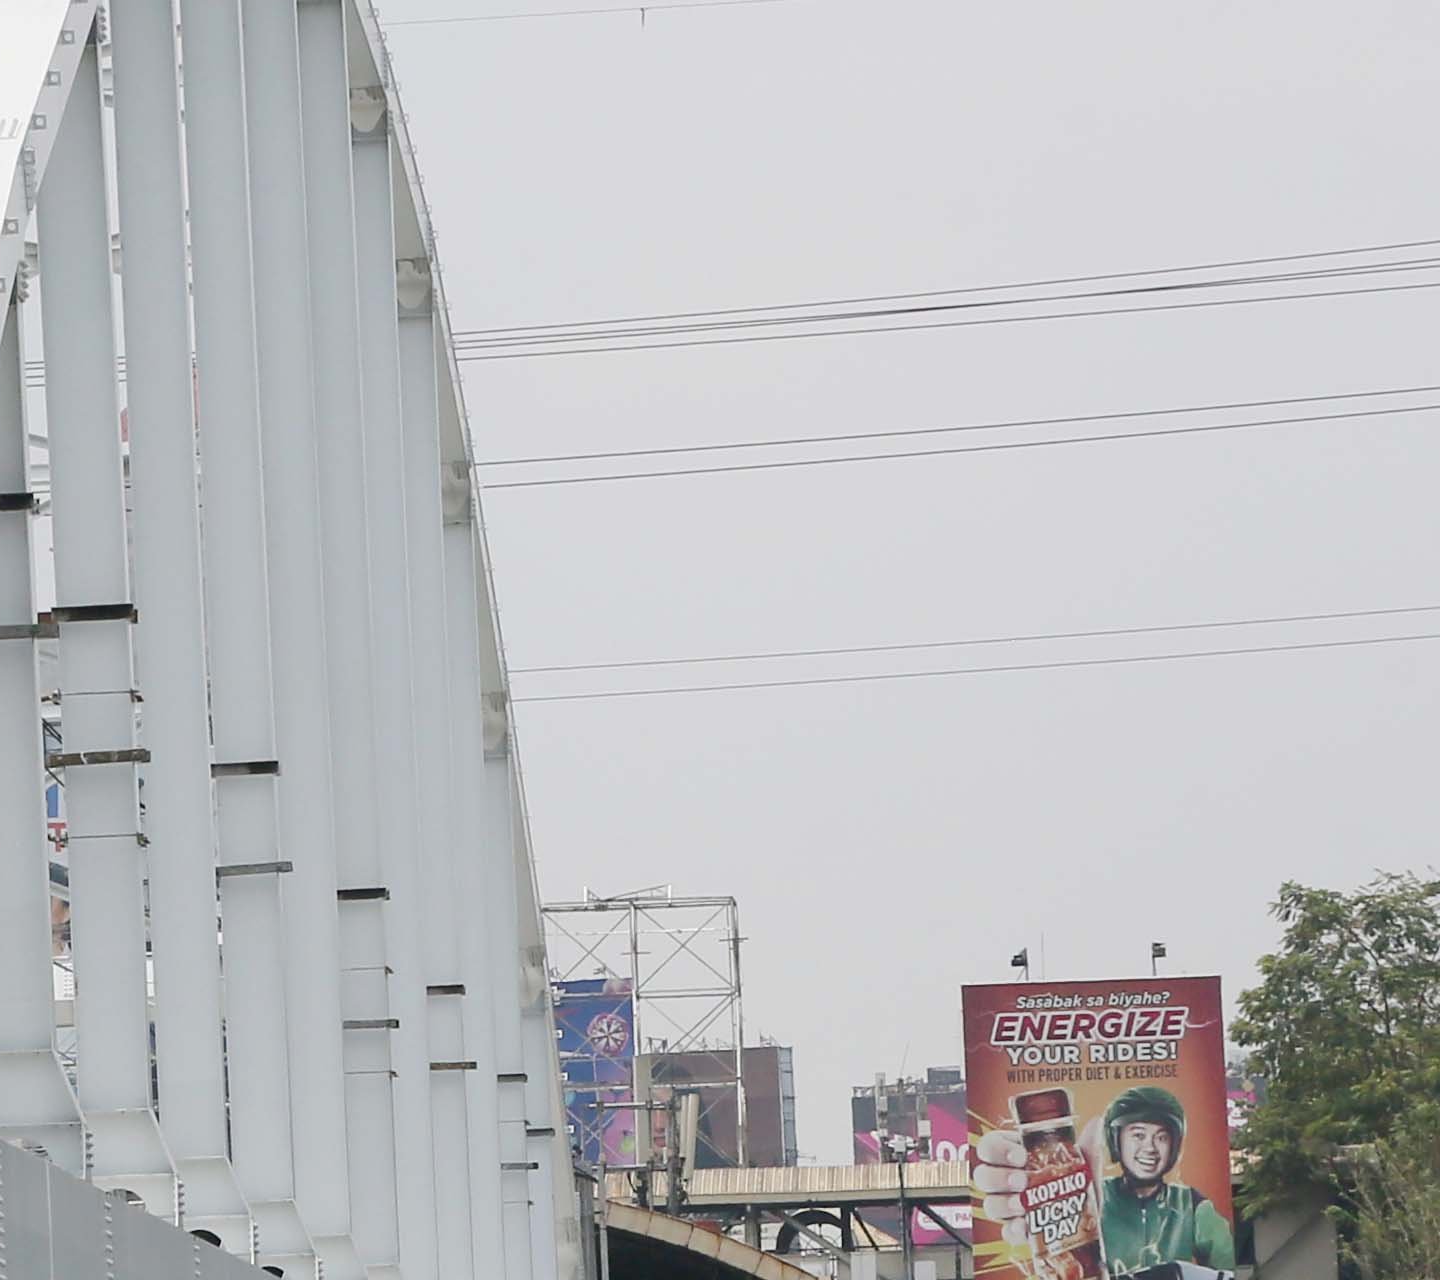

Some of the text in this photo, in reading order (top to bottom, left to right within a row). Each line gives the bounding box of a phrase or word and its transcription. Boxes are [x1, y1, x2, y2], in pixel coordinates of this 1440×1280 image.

[1016, 991, 1170, 1010] Sasabak sa biyahe?
[993, 1008, 1187, 1043] ENERGIZE
[1006, 1041, 1178, 1066] YOUR RIDES!
[1007, 1069, 1035, 1084] WITH
[1038, 1067, 1083, 1083] PROPER
[1086, 1066, 1110, 1081] DIET
[1124, 1063, 1179, 1080] EXERCISE
[1025, 1171, 1087, 1207] KOPIKO
[1028, 1191, 1088, 1236] LUCKY
[1043, 1214, 1080, 1246] DAY
